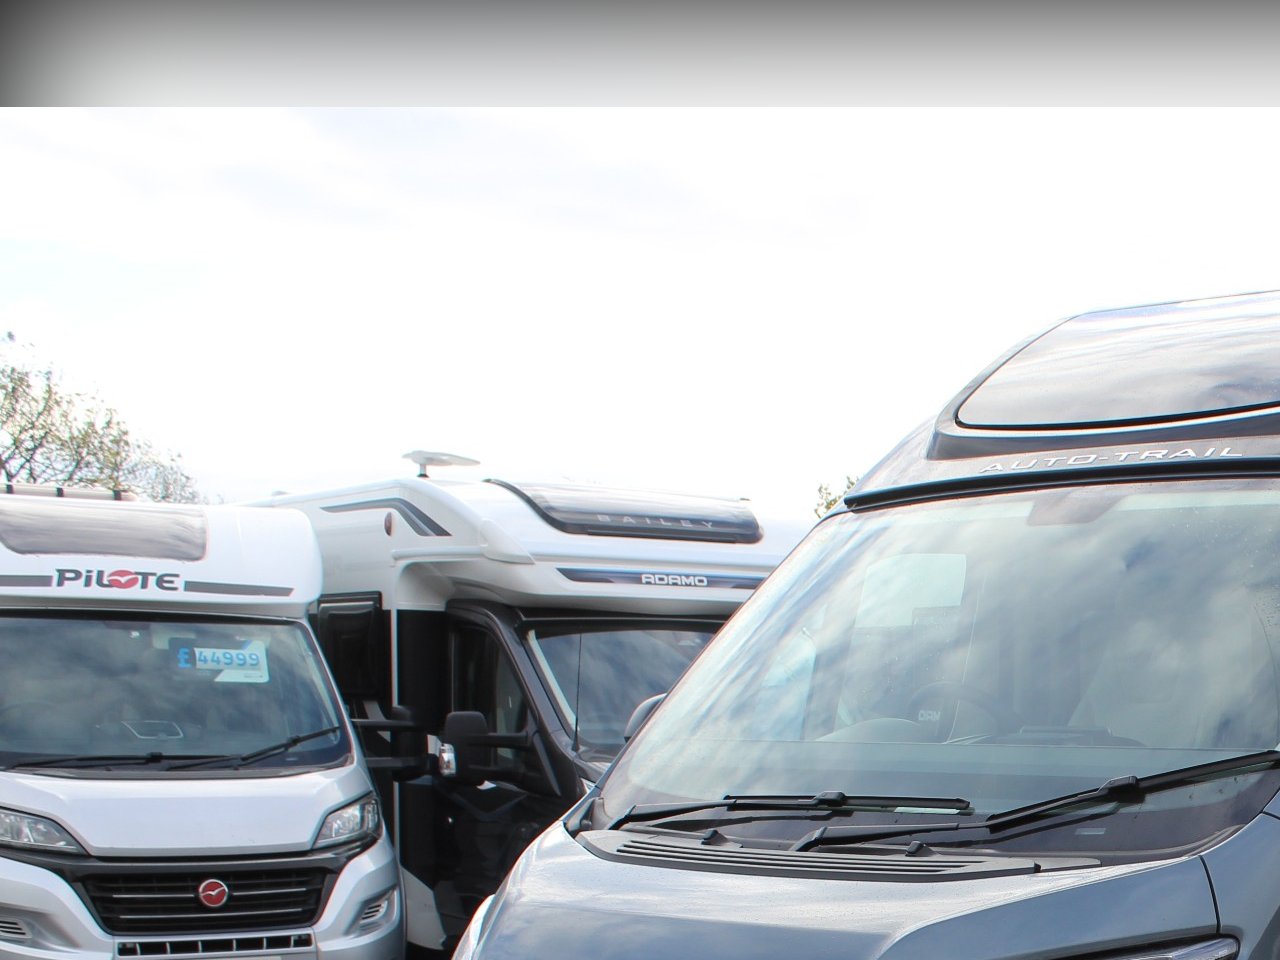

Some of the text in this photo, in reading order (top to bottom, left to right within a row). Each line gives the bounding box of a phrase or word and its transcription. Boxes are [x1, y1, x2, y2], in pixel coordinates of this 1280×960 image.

[979, 446, 1243, 473] AUTO-TRAIL
[597, 514, 713, 529] BAILEY
[641, 573, 708, 587] ADAMO
